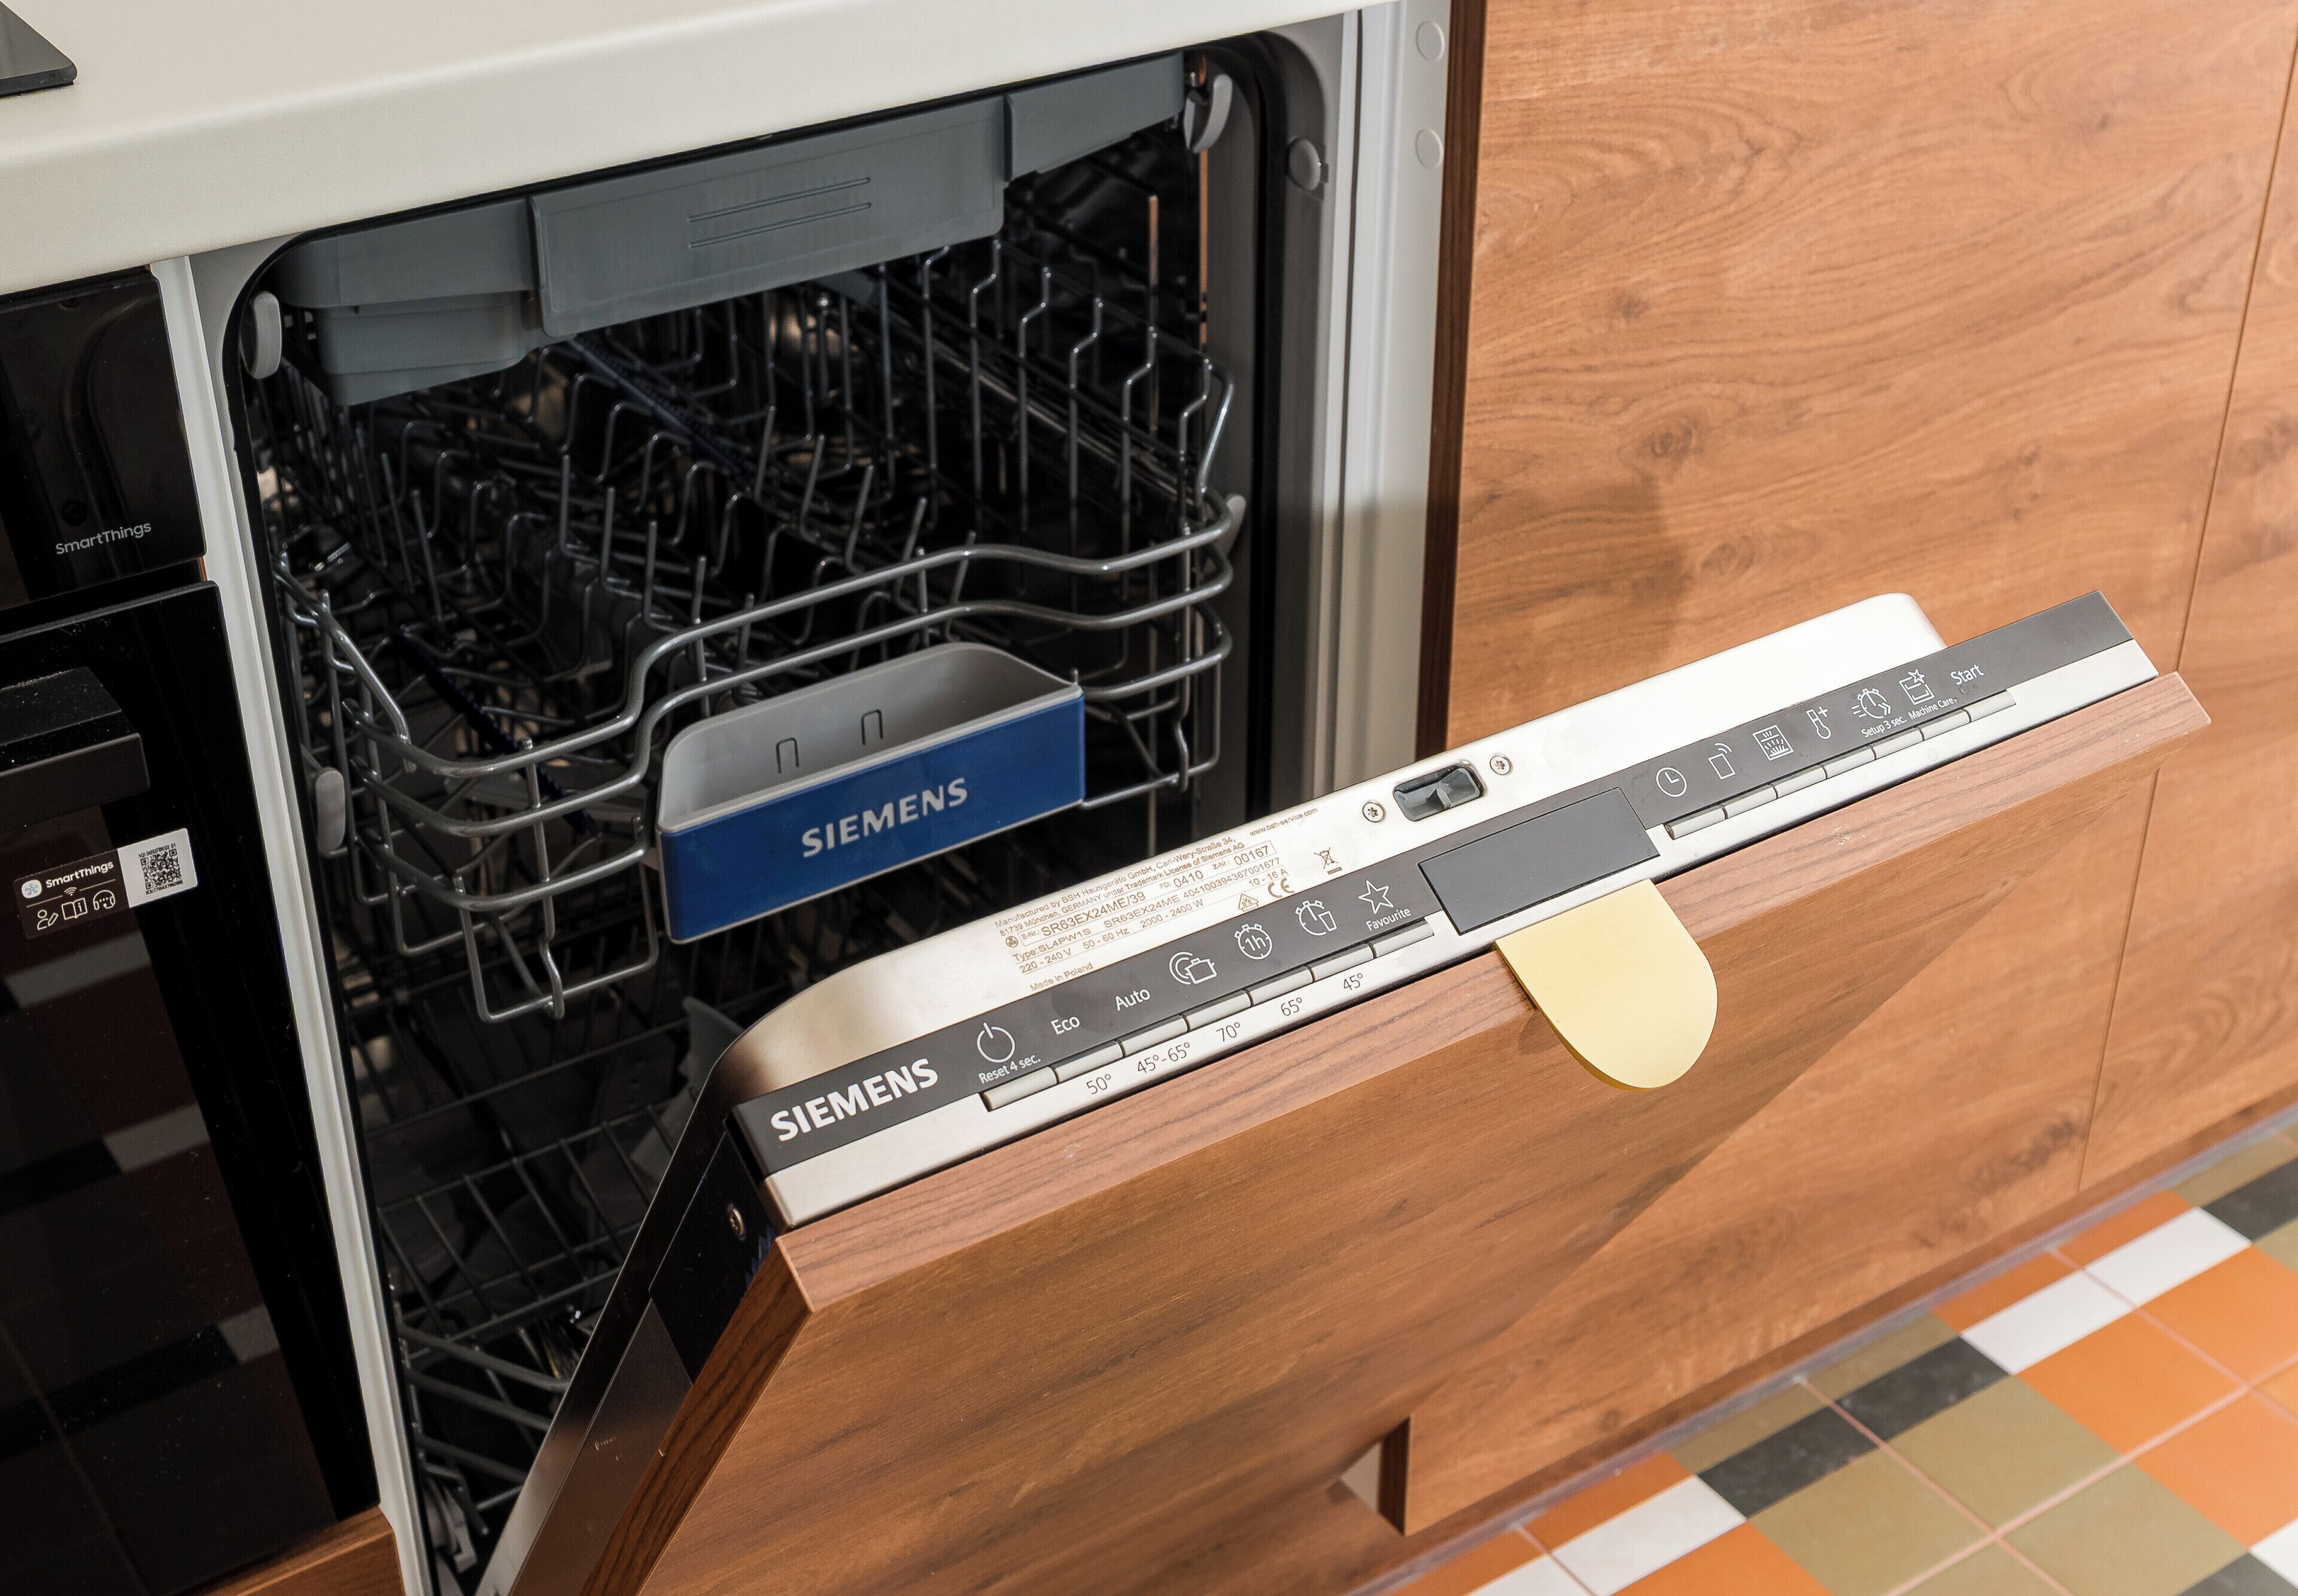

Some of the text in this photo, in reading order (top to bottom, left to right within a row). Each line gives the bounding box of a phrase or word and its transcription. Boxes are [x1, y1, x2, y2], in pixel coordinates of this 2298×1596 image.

[56, 522, 151, 555] SmartThings
[1950, 664, 1984, 685] Start
[1861, 716, 1907, 738] Setup 3 sec.
[1907, 704, 1939, 720] Machine
[801, 777, 968, 858] SIEMENS
[1249, 807, 1318, 837] www.bsh-service.com
[45, 860, 114, 888] SmartThings
[995, 903, 1050, 928] Manufactured
[1061, 892, 1081, 904] BSH
[1081, 876, 1127, 896] Hausgeräte
[1127, 865, 1156, 879] GmbH,
[1156, 842, 1222, 869] Carl-Wery-Straße
[1222, 836, 1236, 845] 34,
[999, 923, 1023, 937] 81739
[1024, 911, 1061, 928] München,
[1061, 893, 1101, 914] GERMANY
[1103, 887, 1124, 898] under
[1124, 872, 1164, 890] Trademark
[1163, 862, 1192, 876] License
[1200, 848, 1232, 862] Siemens
[1233, 842, 1245, 852] AG
[1041, 892, 1145, 937] SR63EX24ME/39
[1173, 870, 1203, 887] 0410
[1233, 845, 1268, 865] 00167
[1104, 894, 1181, 928] SR63EX24ME
[1183, 857, 1279, 898] 404100394367001677
[1019, 961, 1038, 974] 220
[1045, 951, 1063, 964] 240
[1063, 947, 1071, 956] V
[1083, 940, 1095, 950] 50
[1102, 932, 1114, 942] 60
[1115, 928, 1130, 937] Hz
[1140, 914, 1163, 928] 2000
[1169, 903, 1192, 917] 2400
[1192, 898, 1203, 908] W
[1249, 878, 1260, 887] 10
[1267, 871, 1278, 880] 16
[1366, 907, 1412, 932] Favourite
[1245, 935, 1267, 952] 1h
[1029, 978, 1054, 992] Made
[1063, 962, 1094, 979] Poland
[1115, 989, 1151, 1011] Auto
[1050, 1016, 1081, 1035] Eco
[978, 1056, 1041, 1085] Reset 4 sec.
[770, 1058, 939, 1142] SIEMENS
